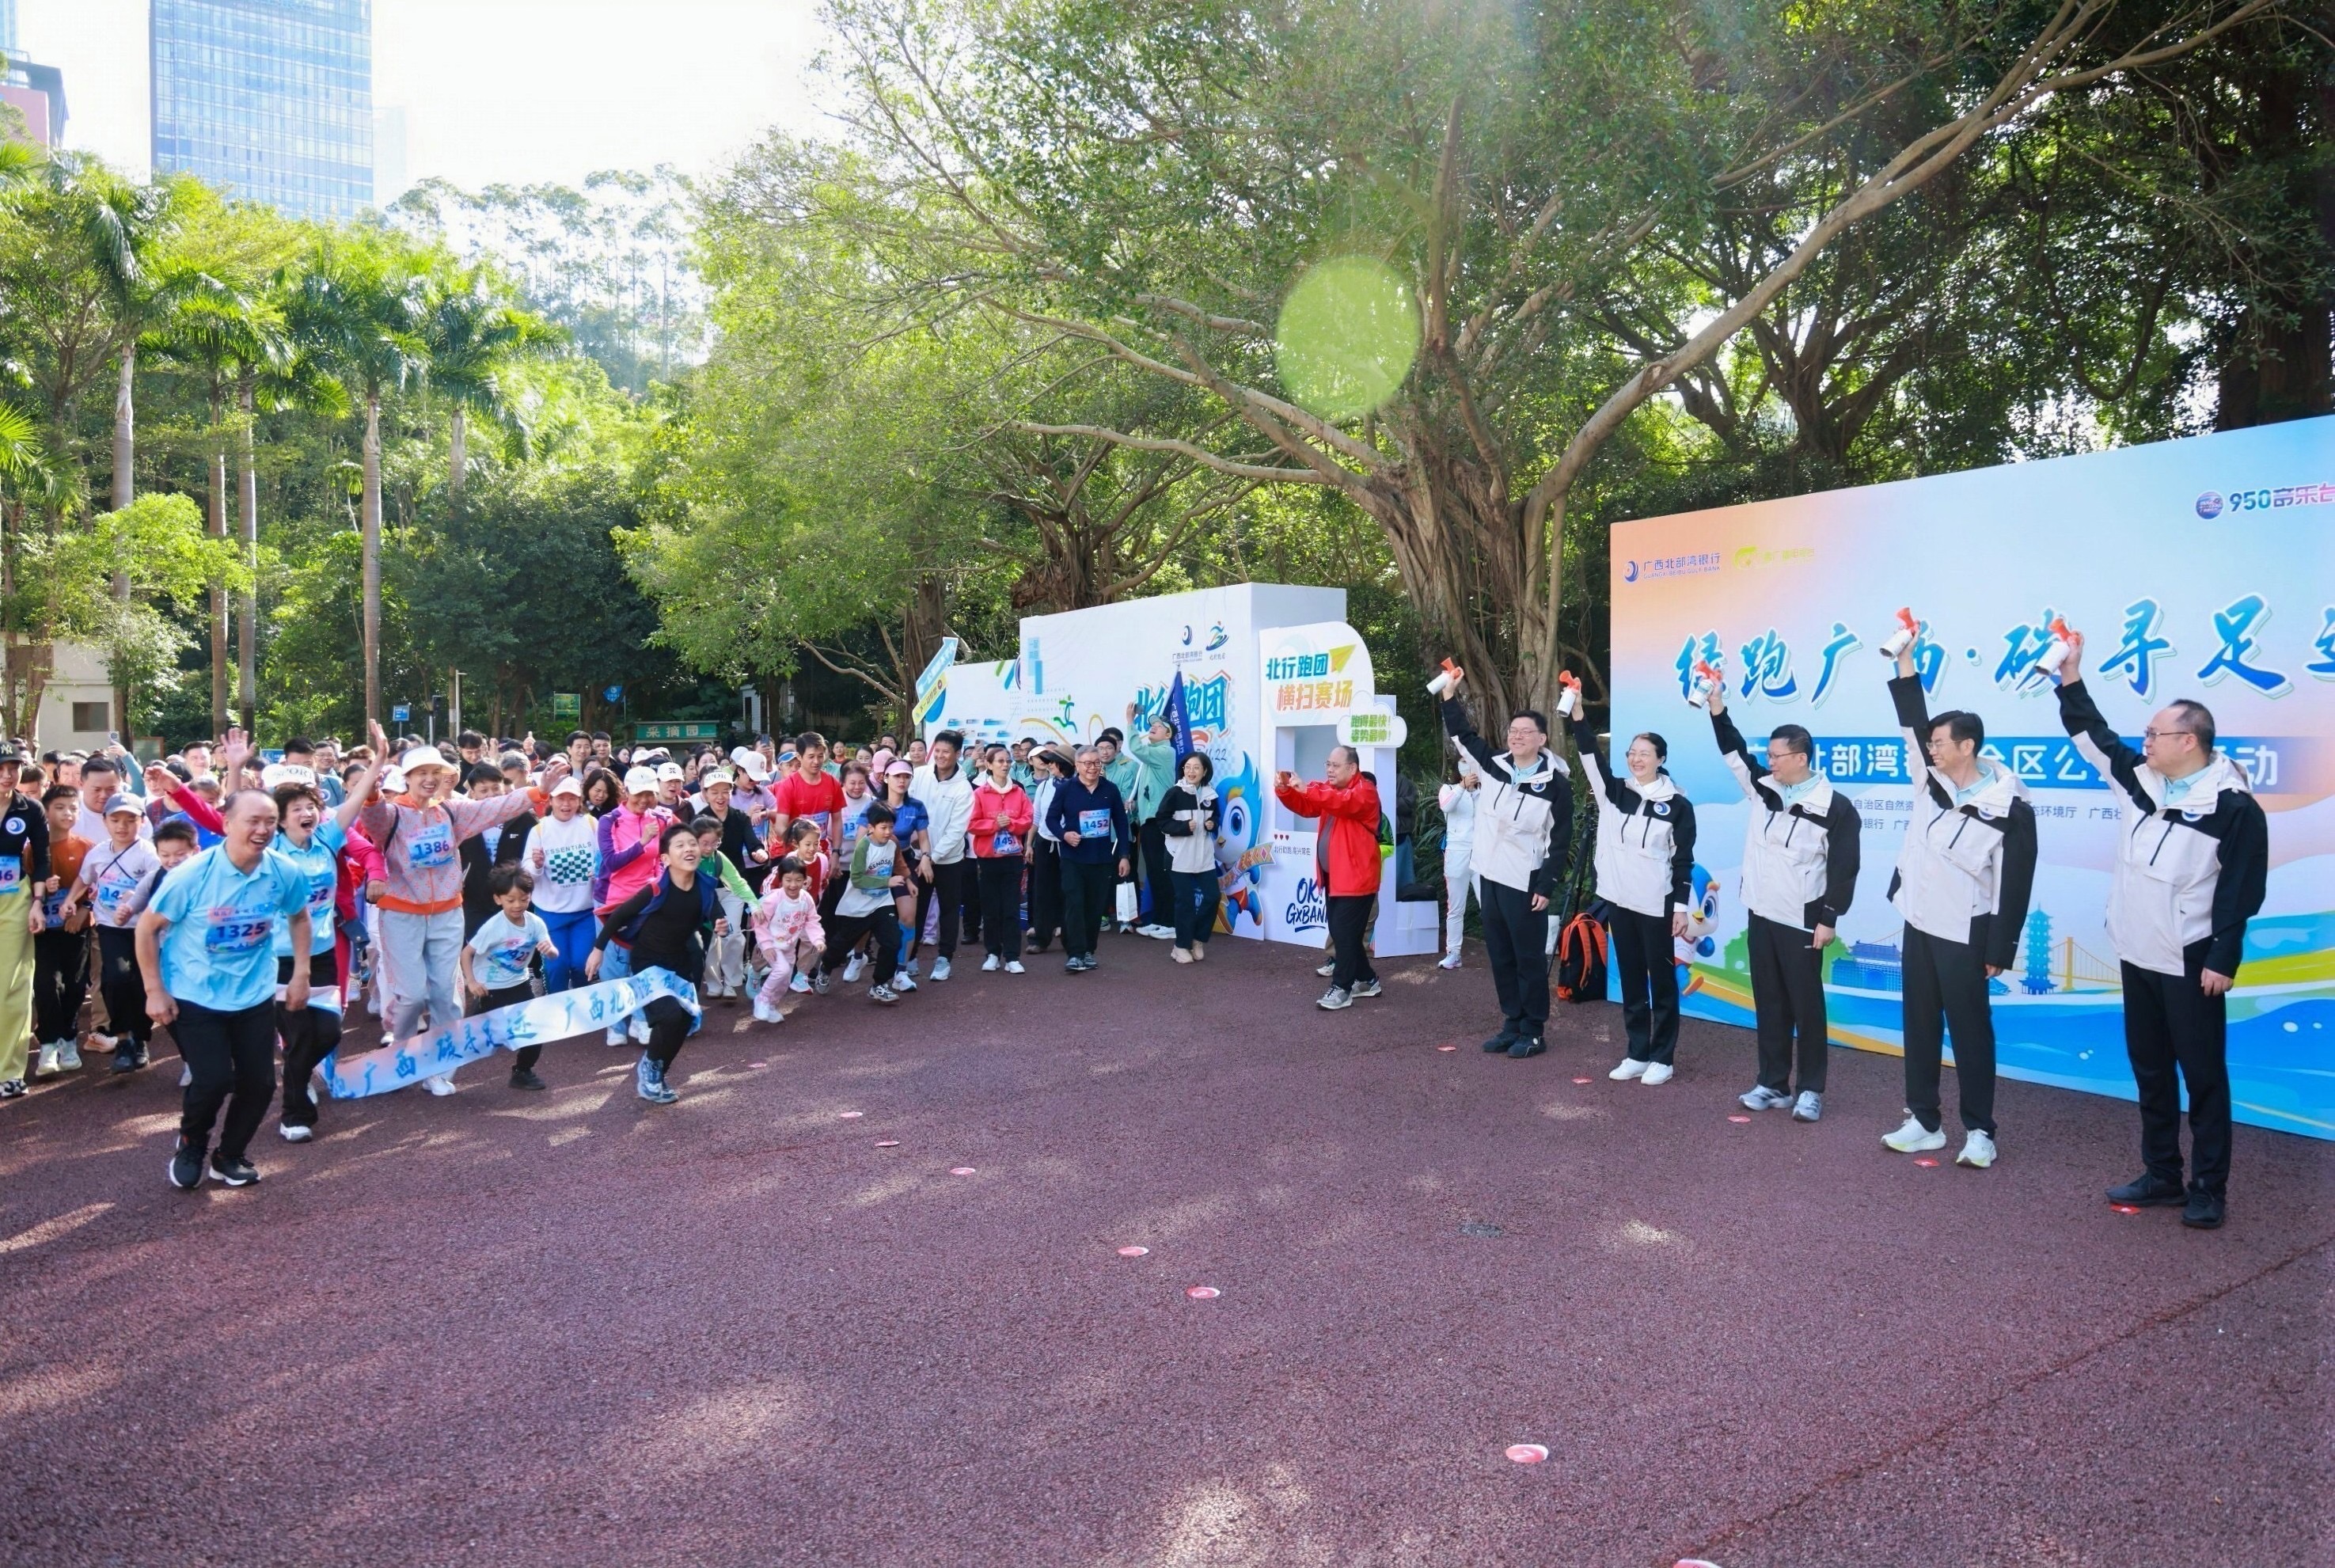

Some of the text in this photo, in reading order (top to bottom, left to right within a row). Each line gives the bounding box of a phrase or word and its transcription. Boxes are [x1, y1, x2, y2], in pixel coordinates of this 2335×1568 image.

[1644, 553, 1721, 572] 广西北部湾银行
[1266, 652, 1329, 680] 北行跑团
[1277, 680, 1353, 712] 横扫赛场
[646, 725, 698, 738] 采摘园
[1084, 818, 1108, 830] 1452
[415, 840, 450, 856] 1386
[545, 841, 592, 855] ESSENTIALS
[216, 922, 266, 939] 1325
